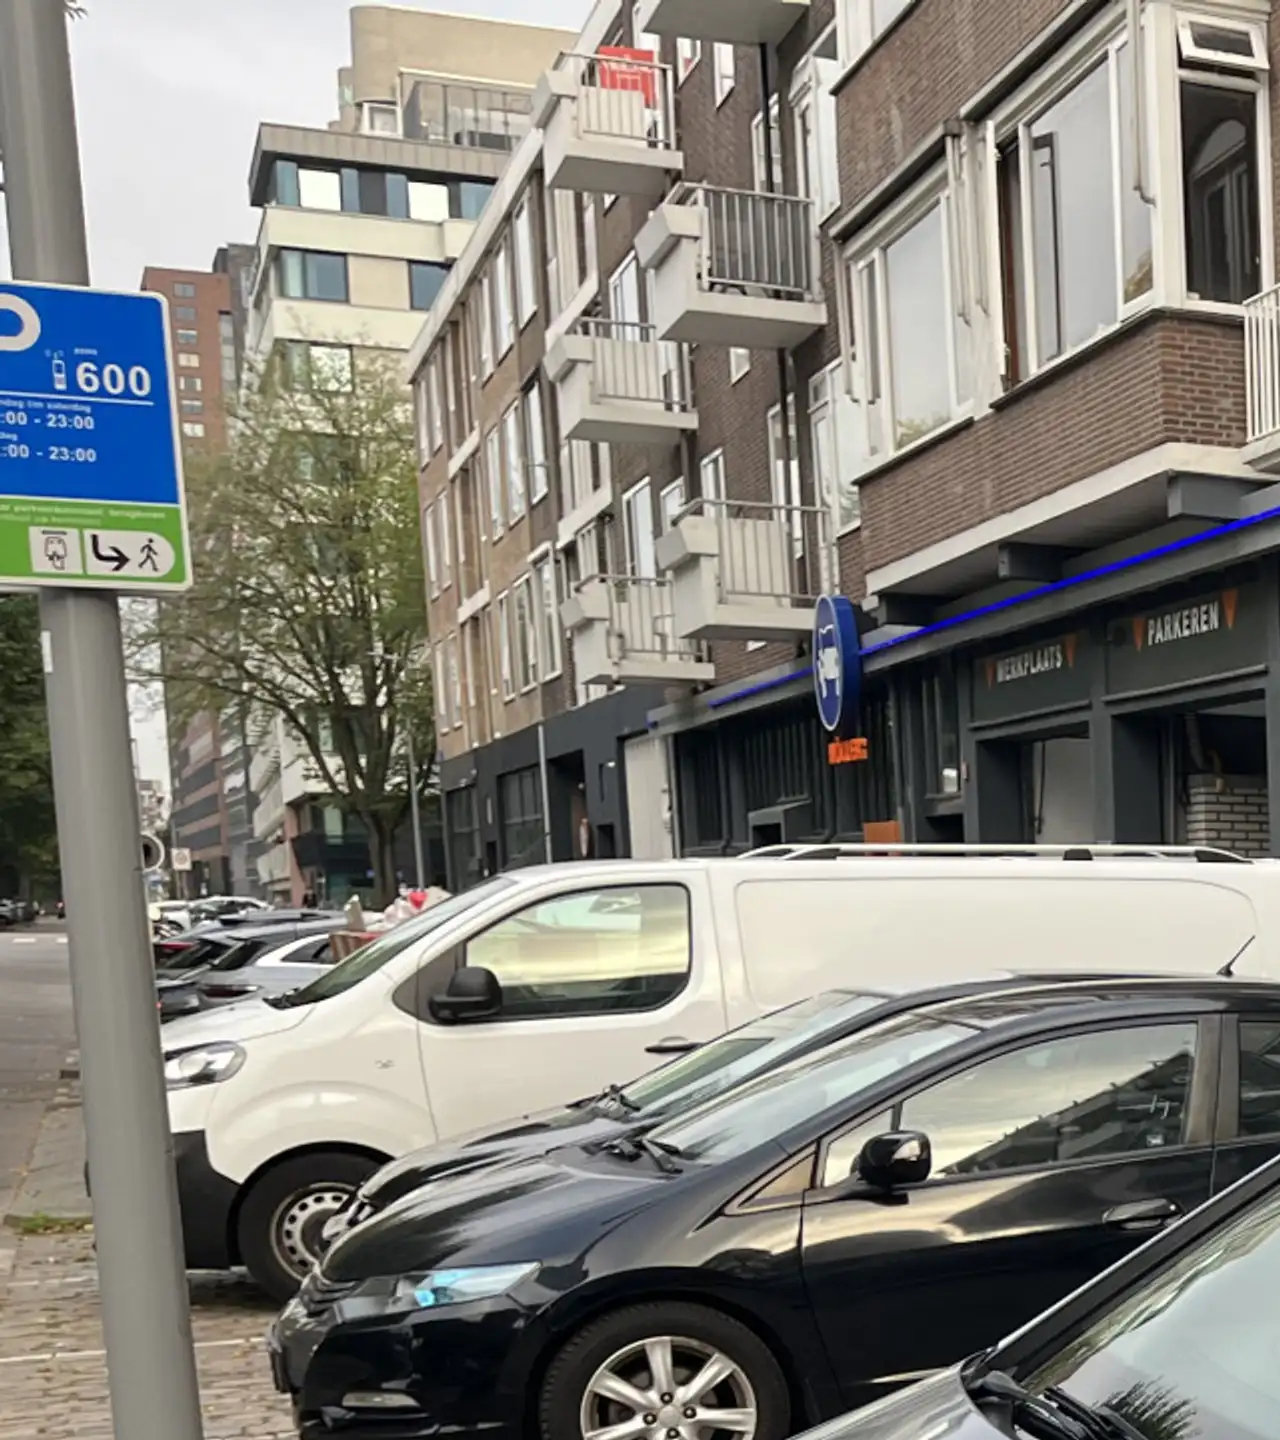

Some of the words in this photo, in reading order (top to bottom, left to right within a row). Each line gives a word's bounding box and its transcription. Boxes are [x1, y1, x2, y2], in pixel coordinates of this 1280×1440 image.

[75, 361, 152, 397] 600
[46, 413, 95, 430] 23:00
[48, 446, 98, 463] 23:00
[1147, 600, 1219, 646] PARKEREN
[996, 643, 1063, 684] WERKPLAATS
